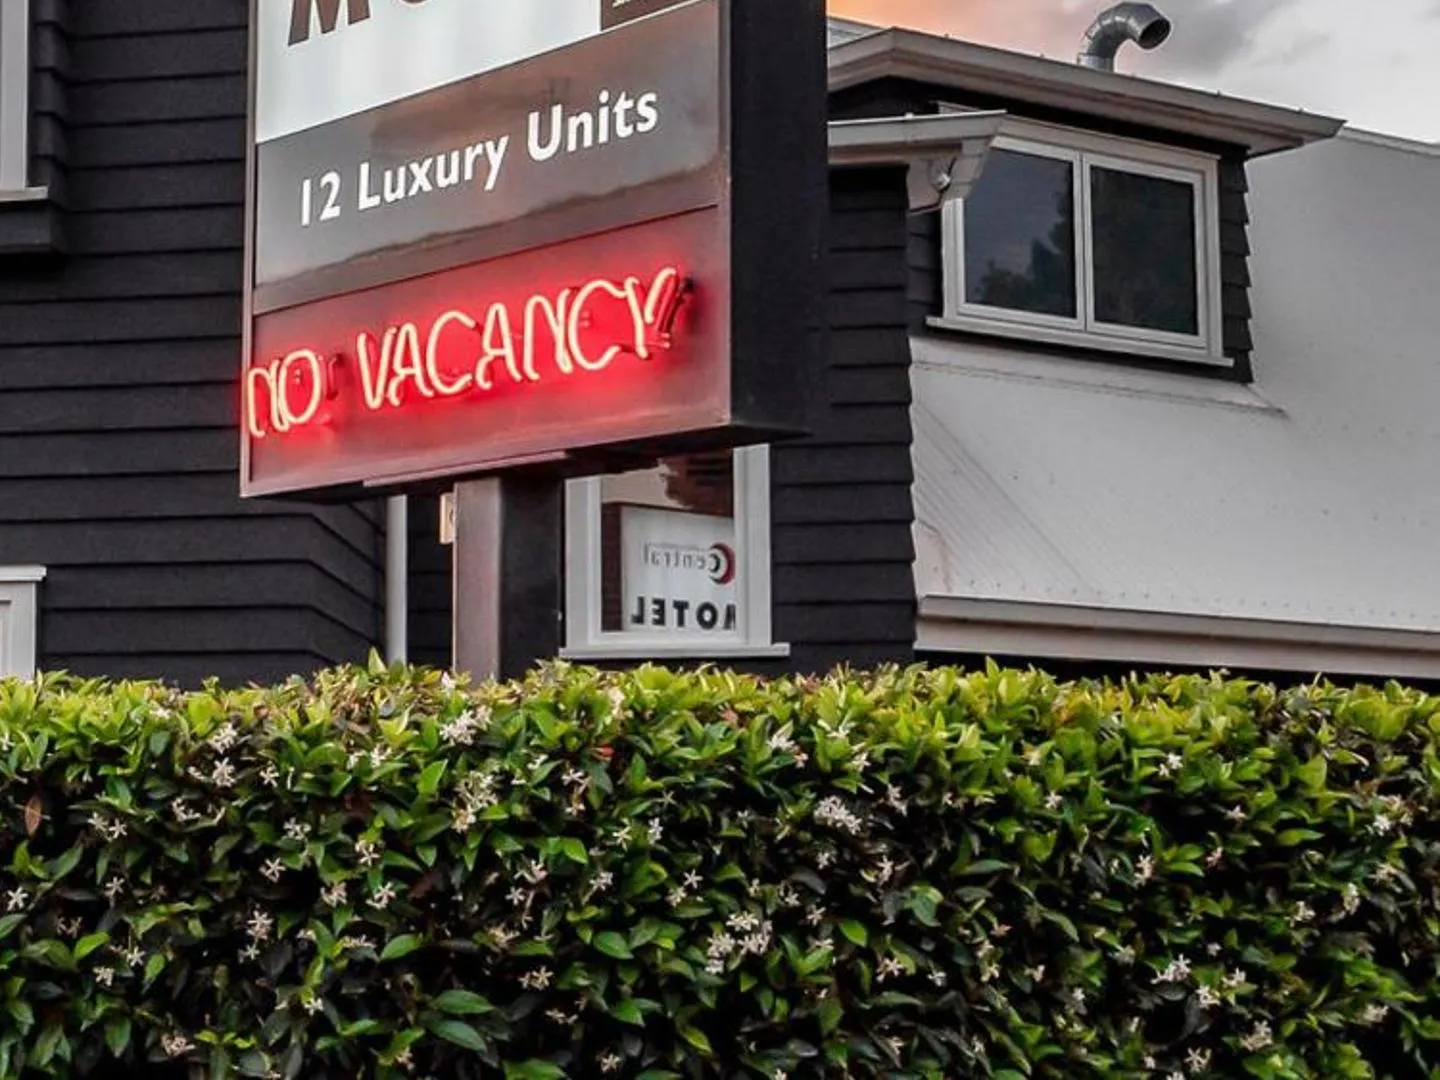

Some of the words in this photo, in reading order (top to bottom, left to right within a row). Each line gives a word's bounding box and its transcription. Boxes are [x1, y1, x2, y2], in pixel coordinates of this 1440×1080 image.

[301, 170, 342, 226] 12
[358, 133, 510, 211] Luxury
[527, 89, 659, 162] Units
[247, 349, 322, 438] NO
[357, 267, 678, 410] VACANCY
